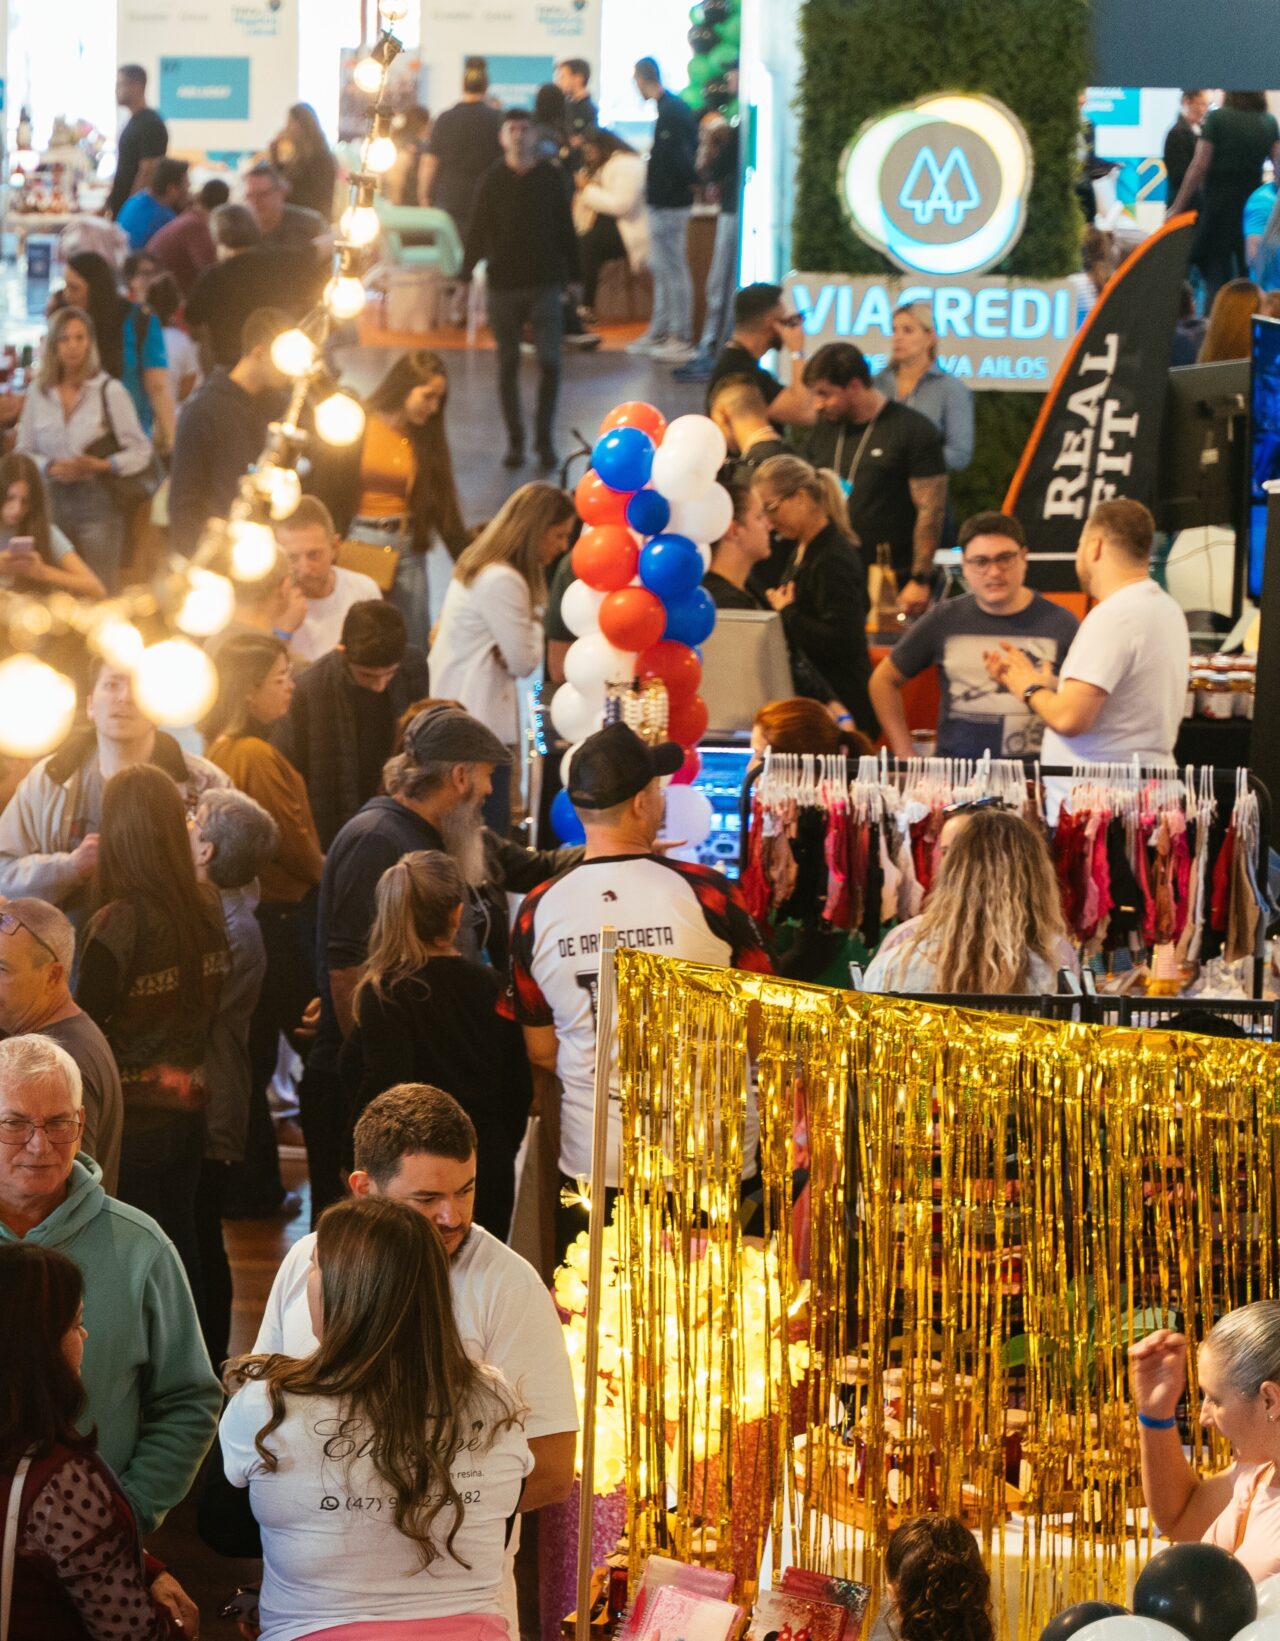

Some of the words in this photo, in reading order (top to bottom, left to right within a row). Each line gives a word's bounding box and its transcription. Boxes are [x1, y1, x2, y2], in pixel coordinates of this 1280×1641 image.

[978, 355, 1048, 379] AILOS
[1043, 333, 1119, 520] REAL
[558, 938, 576, 958] DE
[580, 926, 674, 954] ARSCAETA
[346, 1497, 382, 1512] (47)
